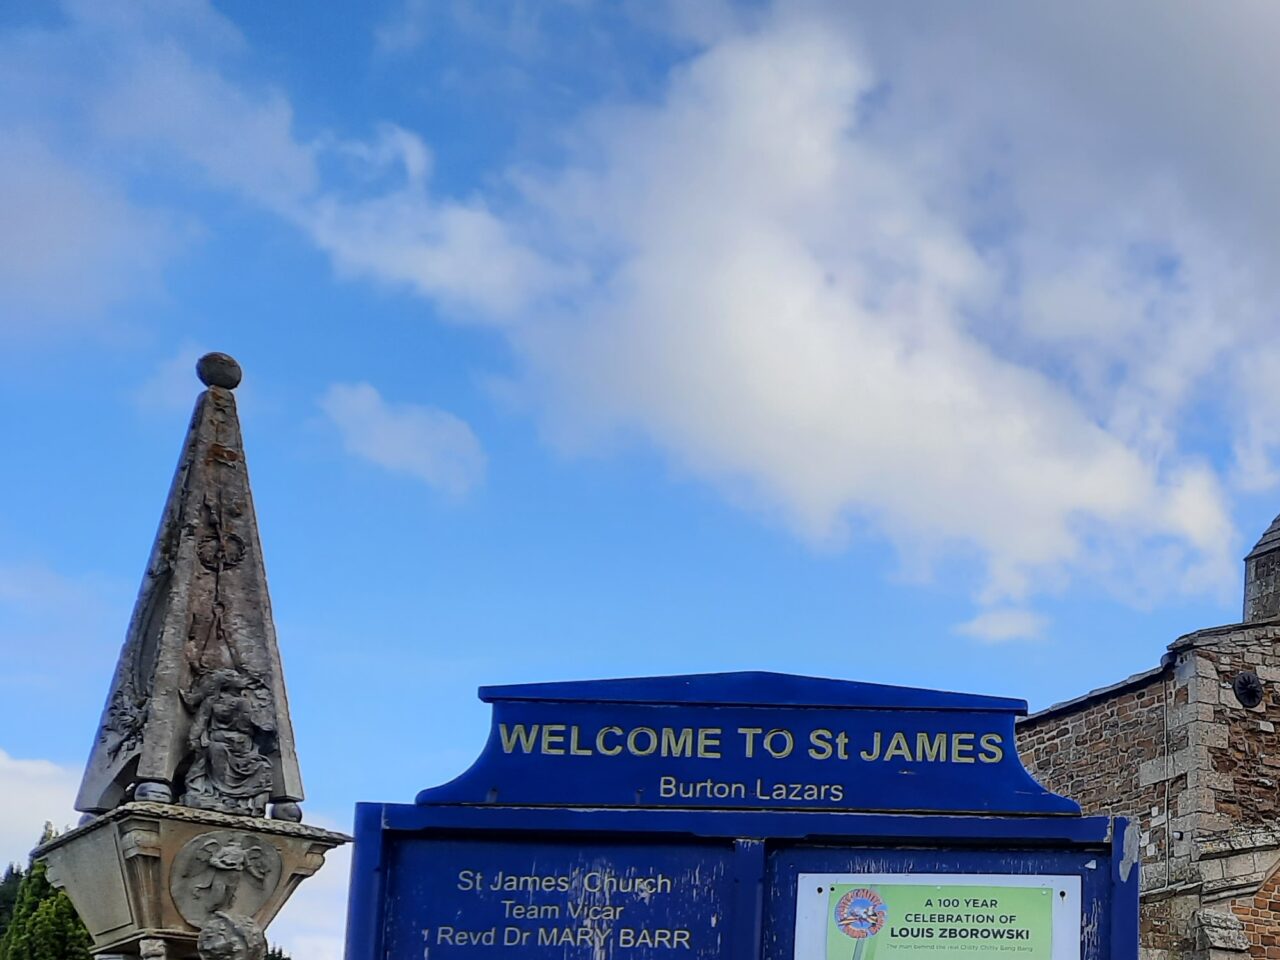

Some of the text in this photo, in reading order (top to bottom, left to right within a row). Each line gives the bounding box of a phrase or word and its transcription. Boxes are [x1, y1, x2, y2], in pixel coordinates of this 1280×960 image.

[499, 723, 1004, 764] WELCOME TO St JAMES
[659, 776, 844, 802] Burton Lazars
[457, 870, 483, 891] St
[583, 872, 672, 894] Church
[500, 900, 625, 921] Team Vicar
[924, 898, 998, 909] A 100 YEAR
[904, 913, 1017, 924] CELEBRATION OF
[436, 927, 691, 950] Revd Dr MARY BARR
[890, 927, 1030, 940] LOUIS ZBOROWSKI
